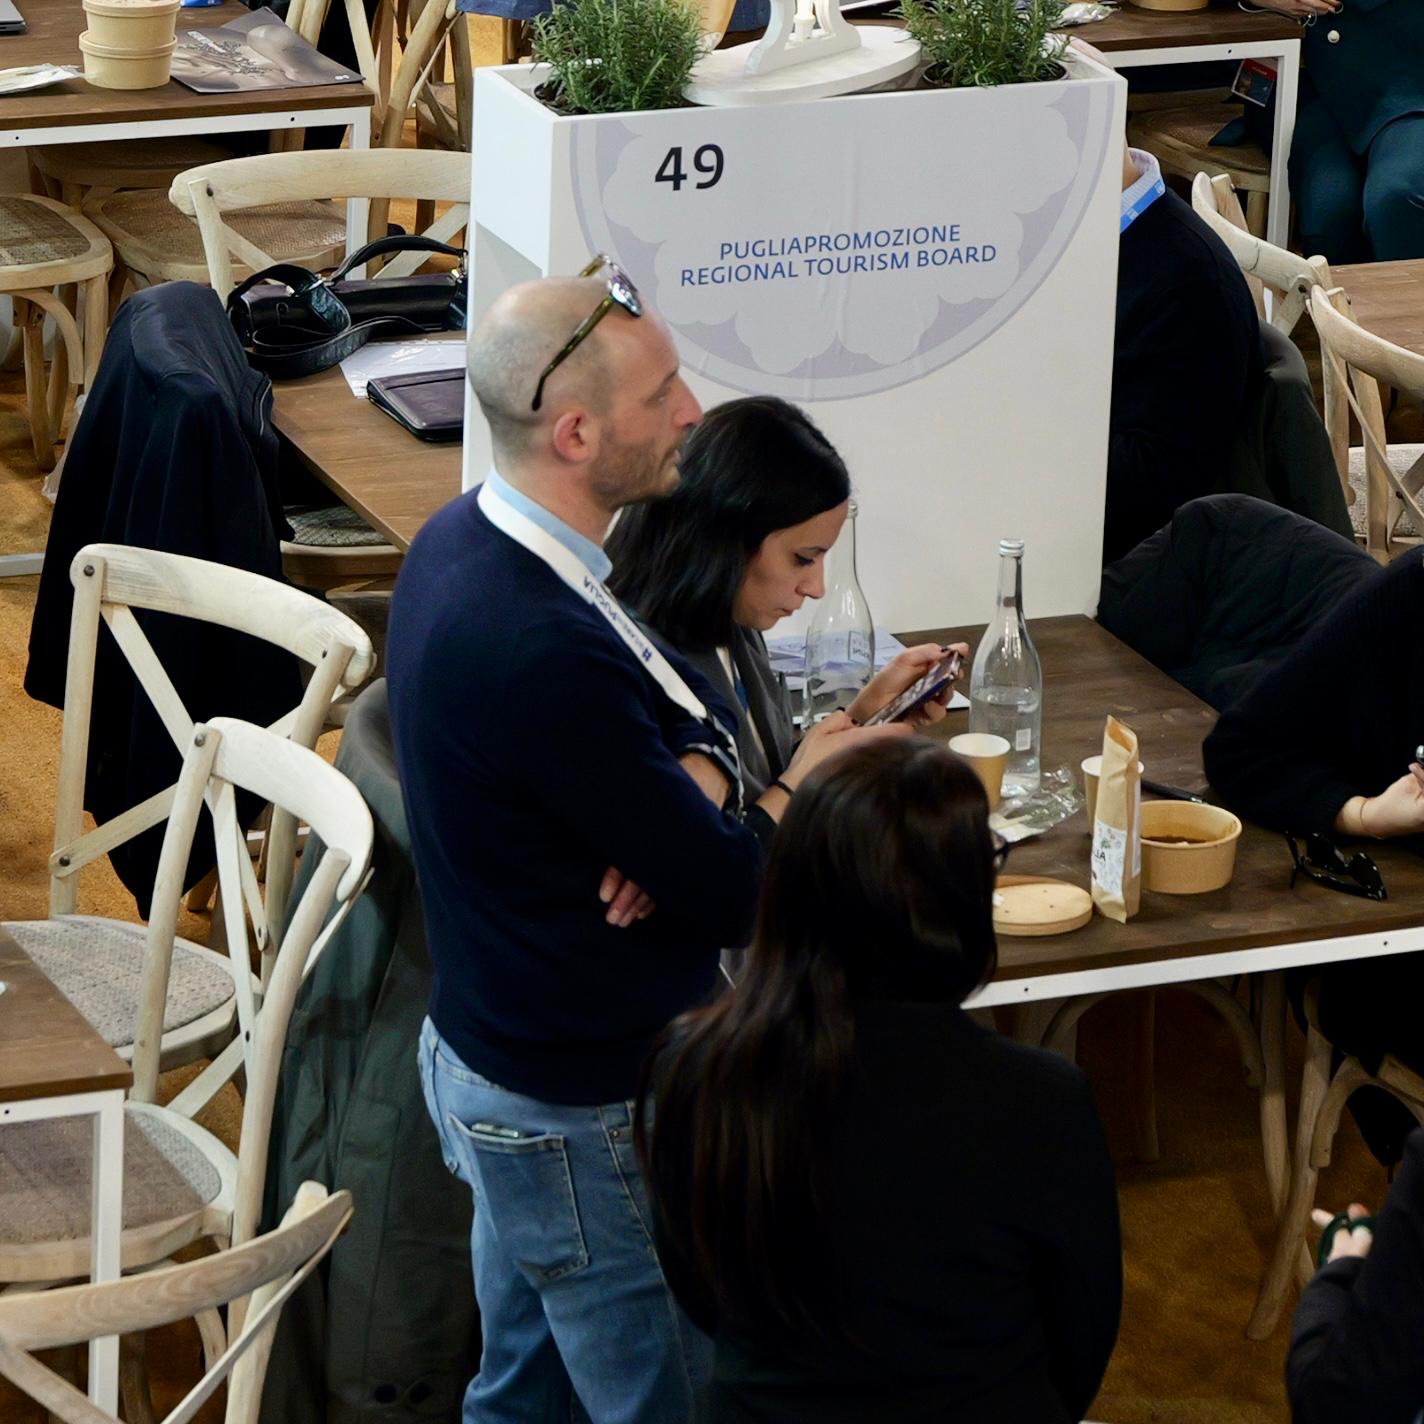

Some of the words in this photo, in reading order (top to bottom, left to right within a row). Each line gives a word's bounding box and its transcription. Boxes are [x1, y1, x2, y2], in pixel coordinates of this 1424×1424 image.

[654, 143, 725, 192] 49
[720, 224, 961, 261] PUGLIAPROMOZIONE
[681, 260, 799, 287] REGIONAL
[804, 251, 909, 277] TOURISM
[917, 244, 997, 268] BOARD
